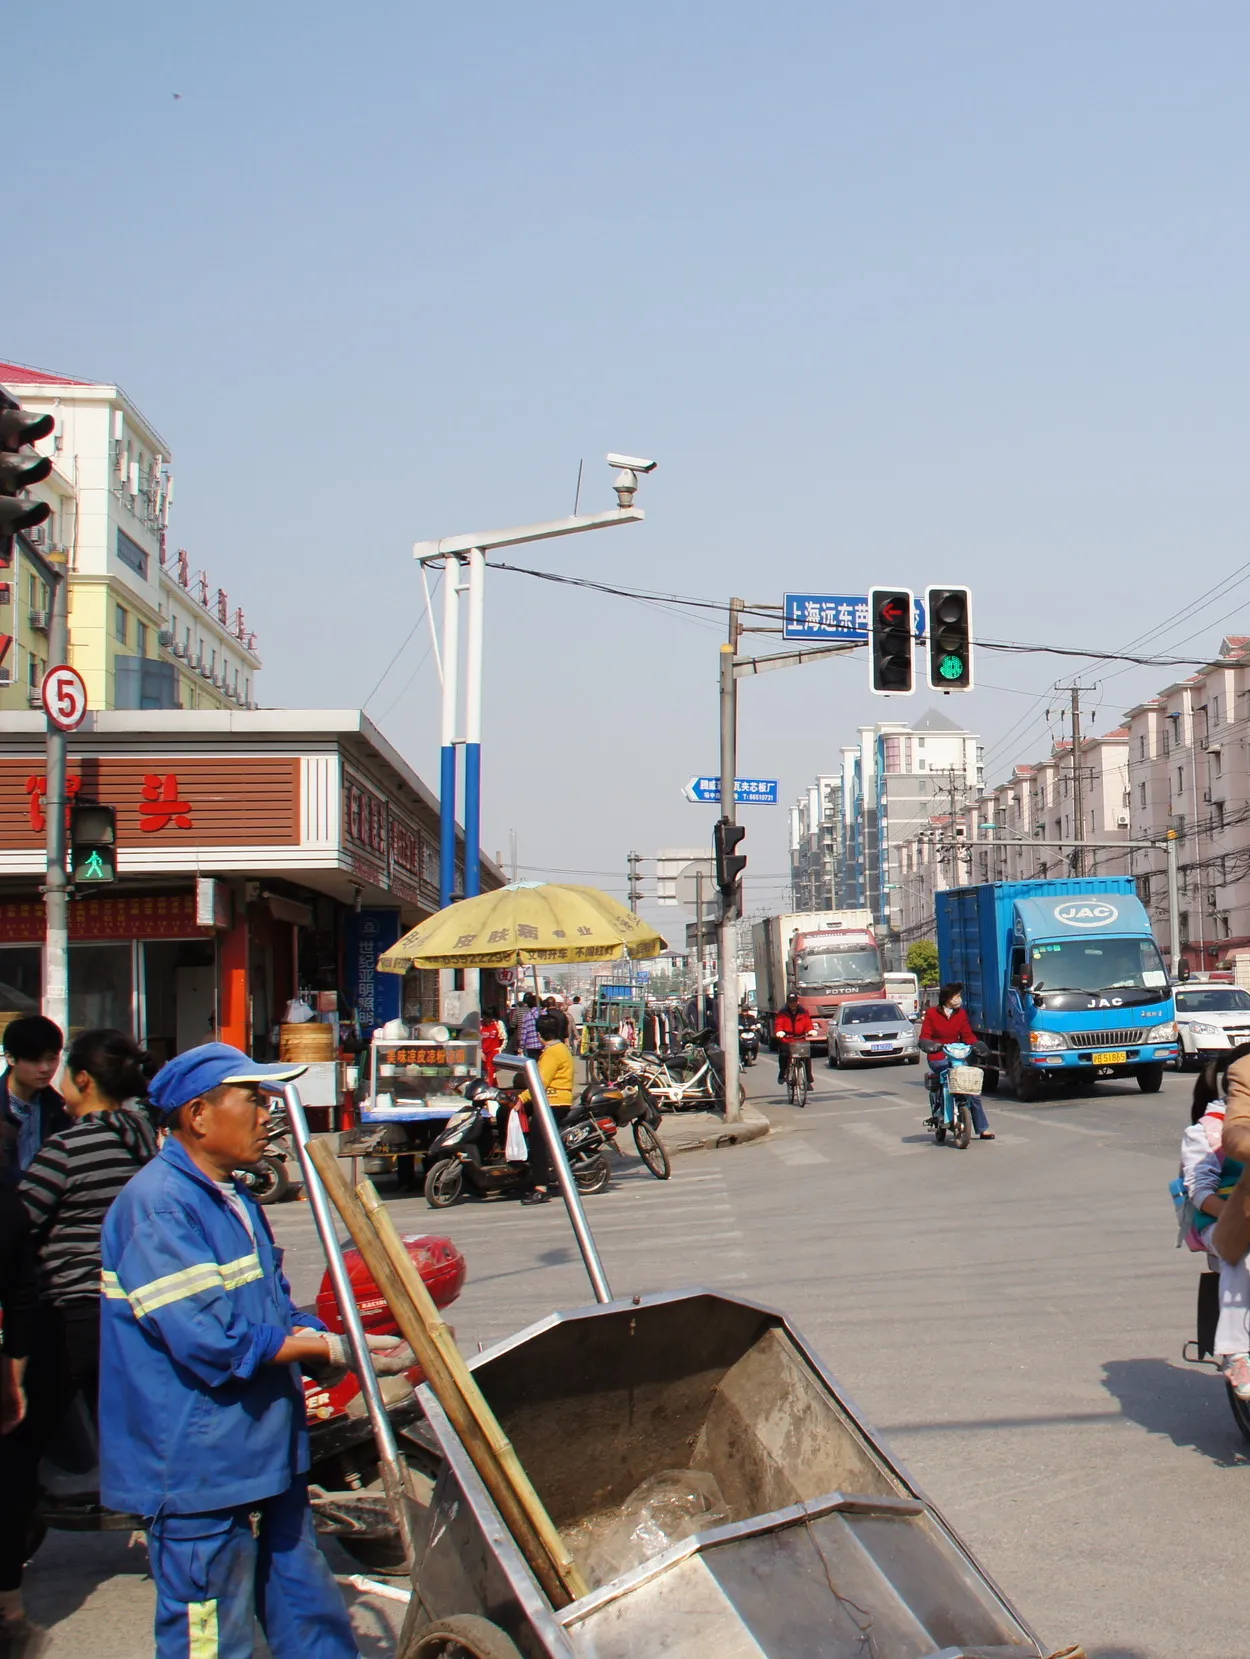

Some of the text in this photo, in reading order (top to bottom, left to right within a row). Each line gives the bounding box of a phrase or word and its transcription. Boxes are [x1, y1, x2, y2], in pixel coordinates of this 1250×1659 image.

[57, 679, 76, 718] 5
[1062, 908, 1110, 918] JAC
[1087, 998, 1123, 1008] JAC
